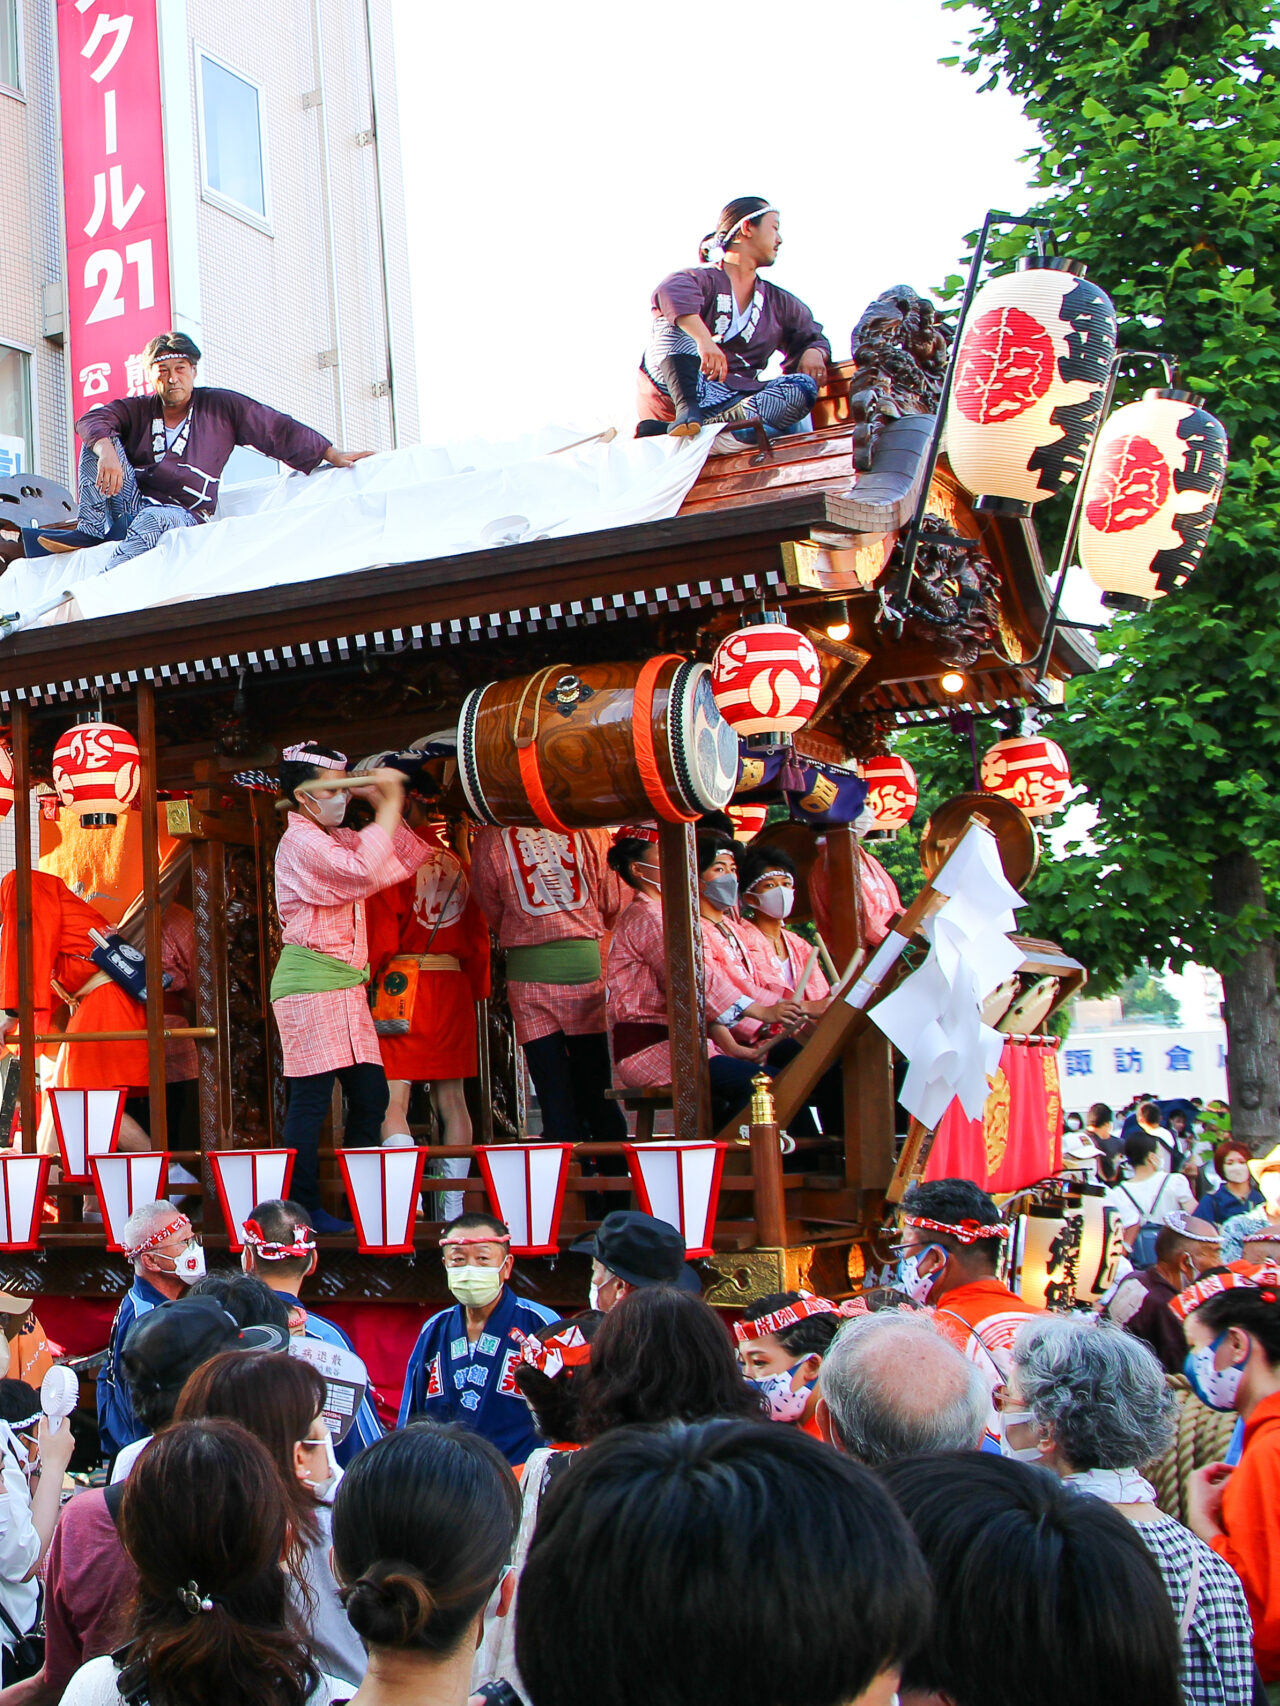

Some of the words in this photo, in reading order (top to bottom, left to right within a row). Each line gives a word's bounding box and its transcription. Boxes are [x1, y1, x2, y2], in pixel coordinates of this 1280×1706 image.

[74, 0, 155, 326] クール21
[1064, 1044, 1227, 1076] 諏訪倉
